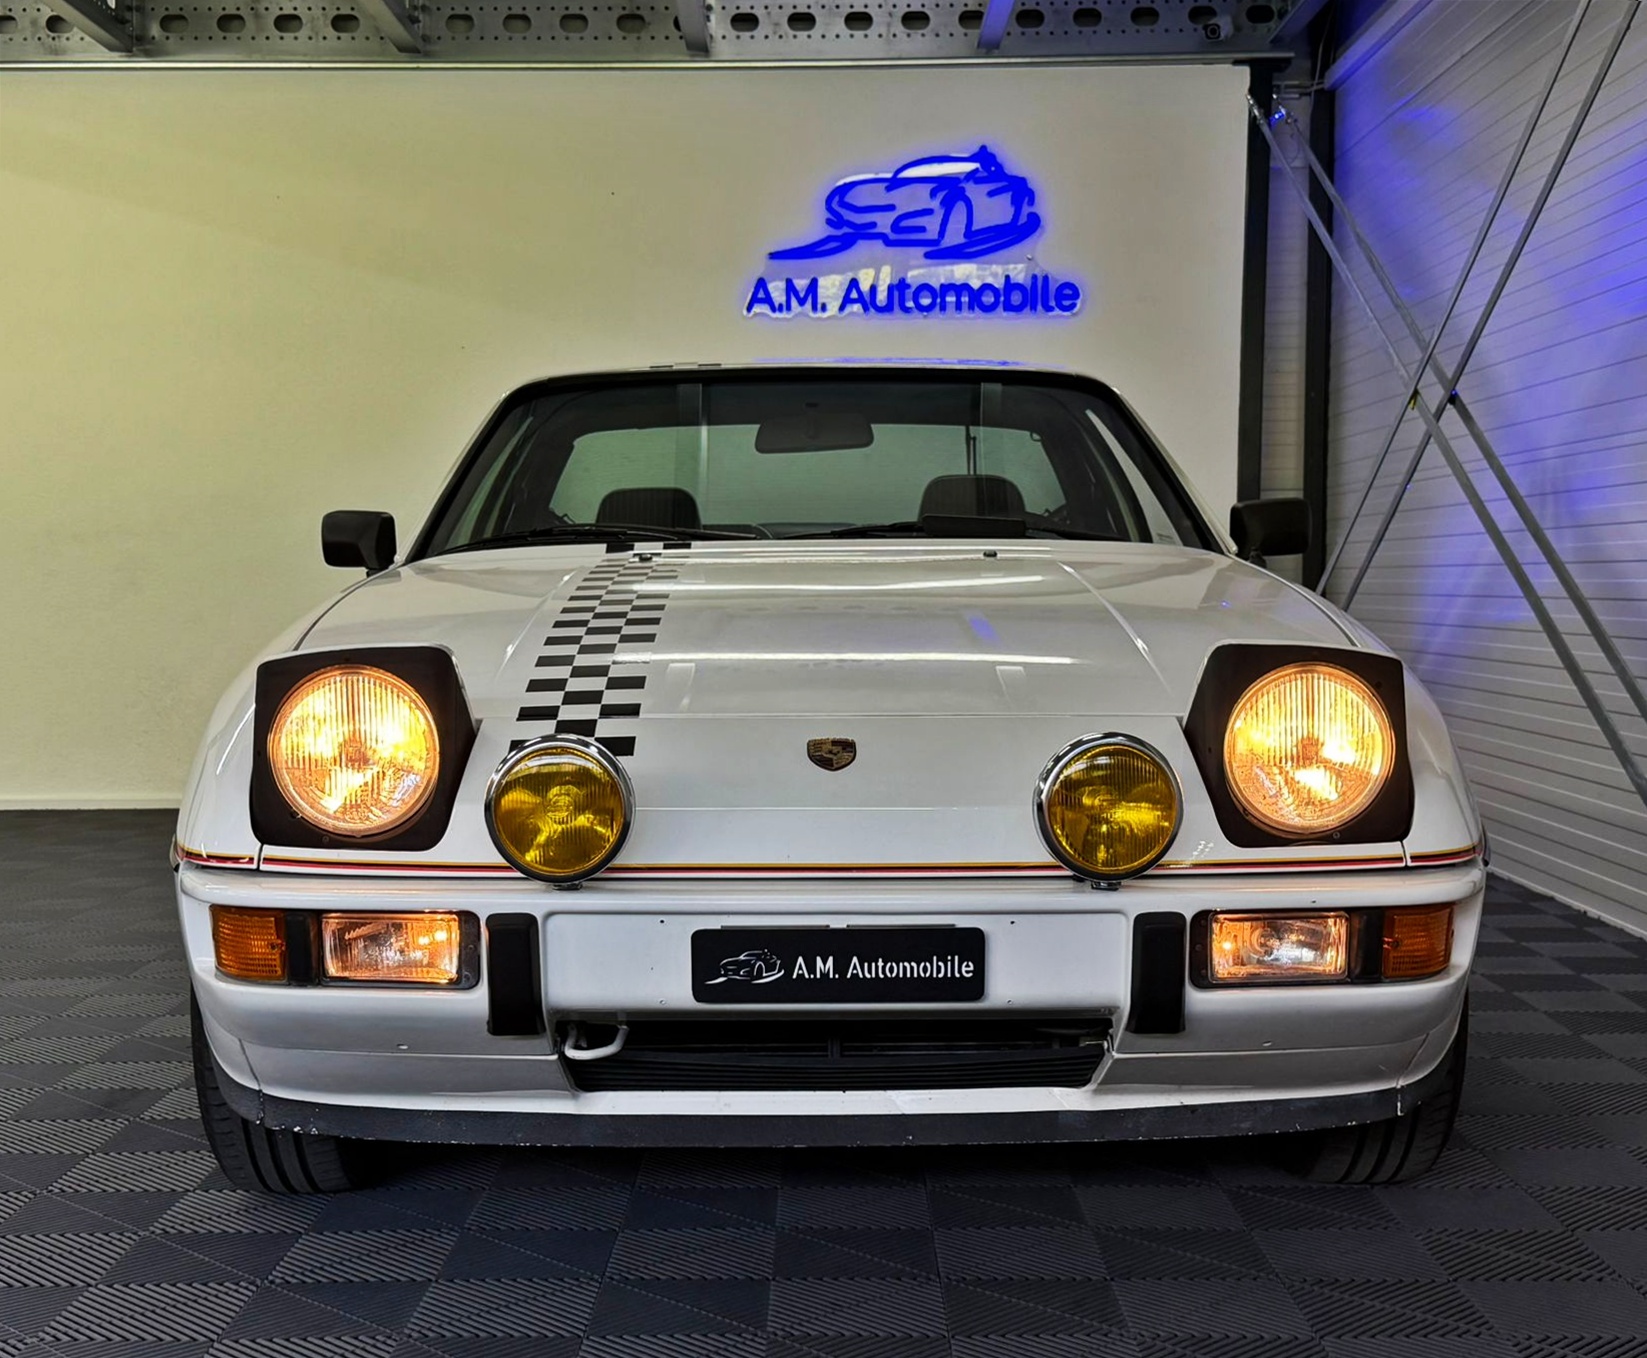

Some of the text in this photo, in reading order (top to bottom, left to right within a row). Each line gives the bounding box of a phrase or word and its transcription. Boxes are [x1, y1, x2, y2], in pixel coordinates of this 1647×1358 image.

[746, 273, 1081, 314] A.M. Automobile
[792, 955, 975, 979] A.M. Automobile
